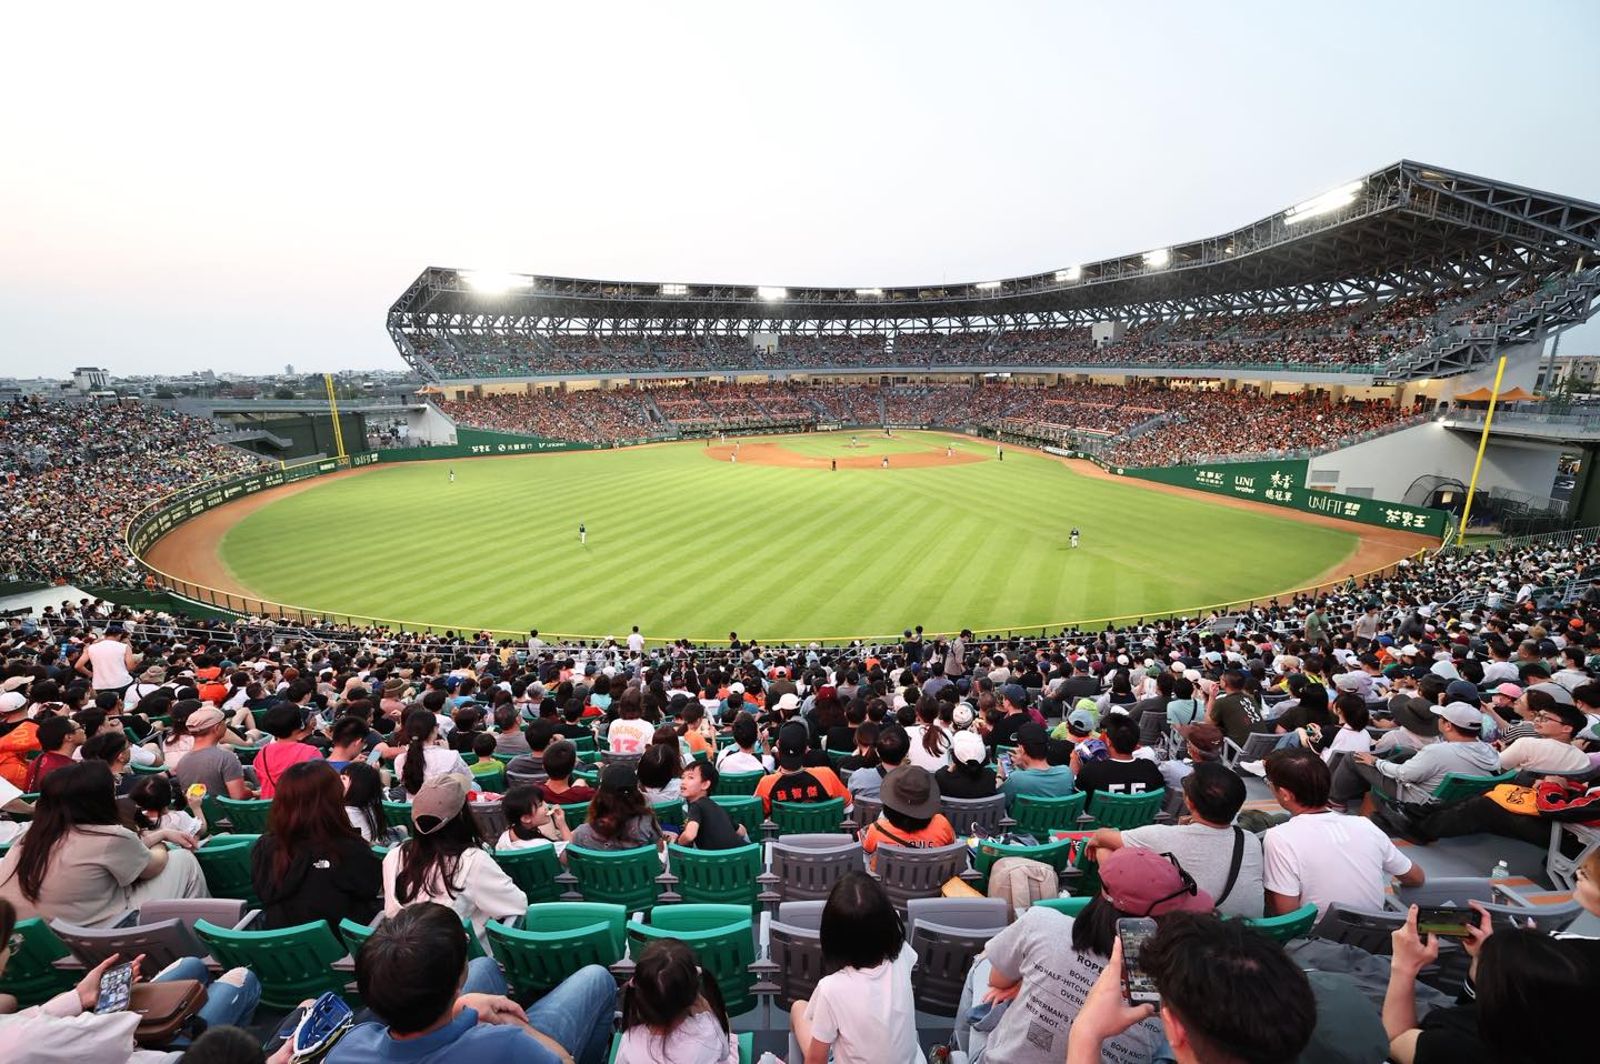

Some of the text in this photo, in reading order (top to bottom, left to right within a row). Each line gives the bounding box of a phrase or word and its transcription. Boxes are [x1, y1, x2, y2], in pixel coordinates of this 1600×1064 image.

[1234, 475, 1254, 487] UNI
[1234, 485, 1256, 494] water
[612, 738, 639, 753] 13
[1039, 1013, 1059, 1028] KNOT
